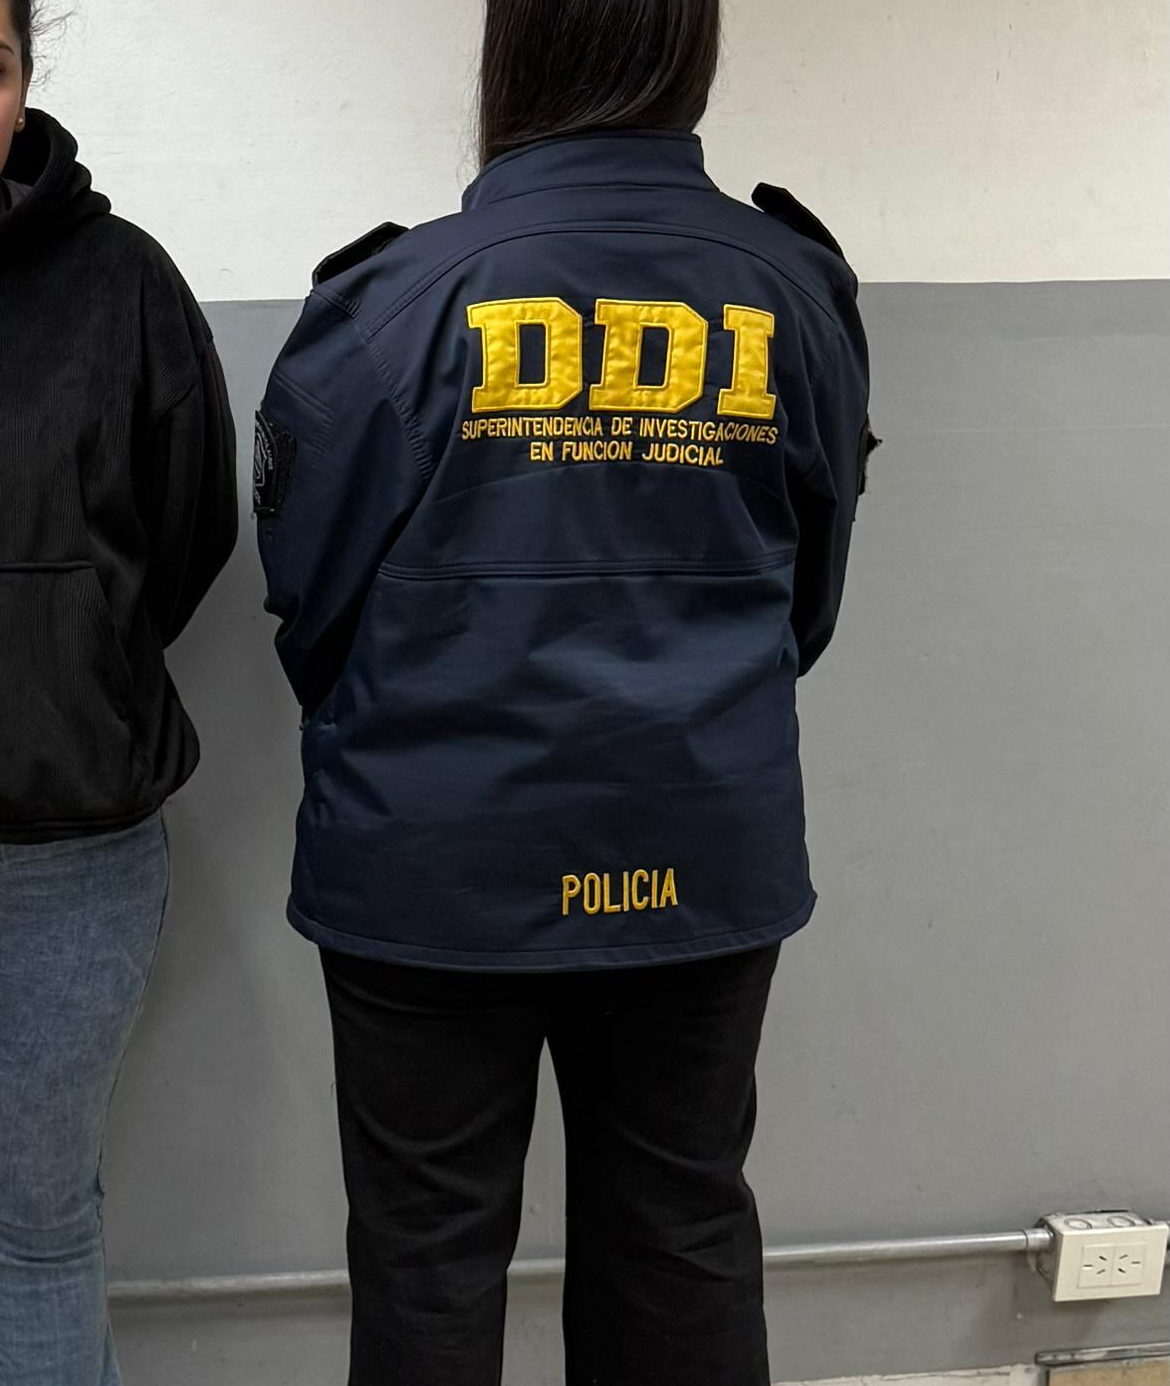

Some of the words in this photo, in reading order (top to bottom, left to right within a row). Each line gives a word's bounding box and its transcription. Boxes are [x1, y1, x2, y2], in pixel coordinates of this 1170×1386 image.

[467, 297, 776, 419] DDI
[461, 417, 603, 441] SUPERINTENDENCIA
[611, 417, 633, 437] DE
[639, 419, 778, 445] INVESTIGACIONES
[530, 442, 554, 461] EN
[562, 441, 631, 461] FUNCION
[642, 442, 724, 466] JUDICIAL
[562, 868, 679, 916] POLICIA
